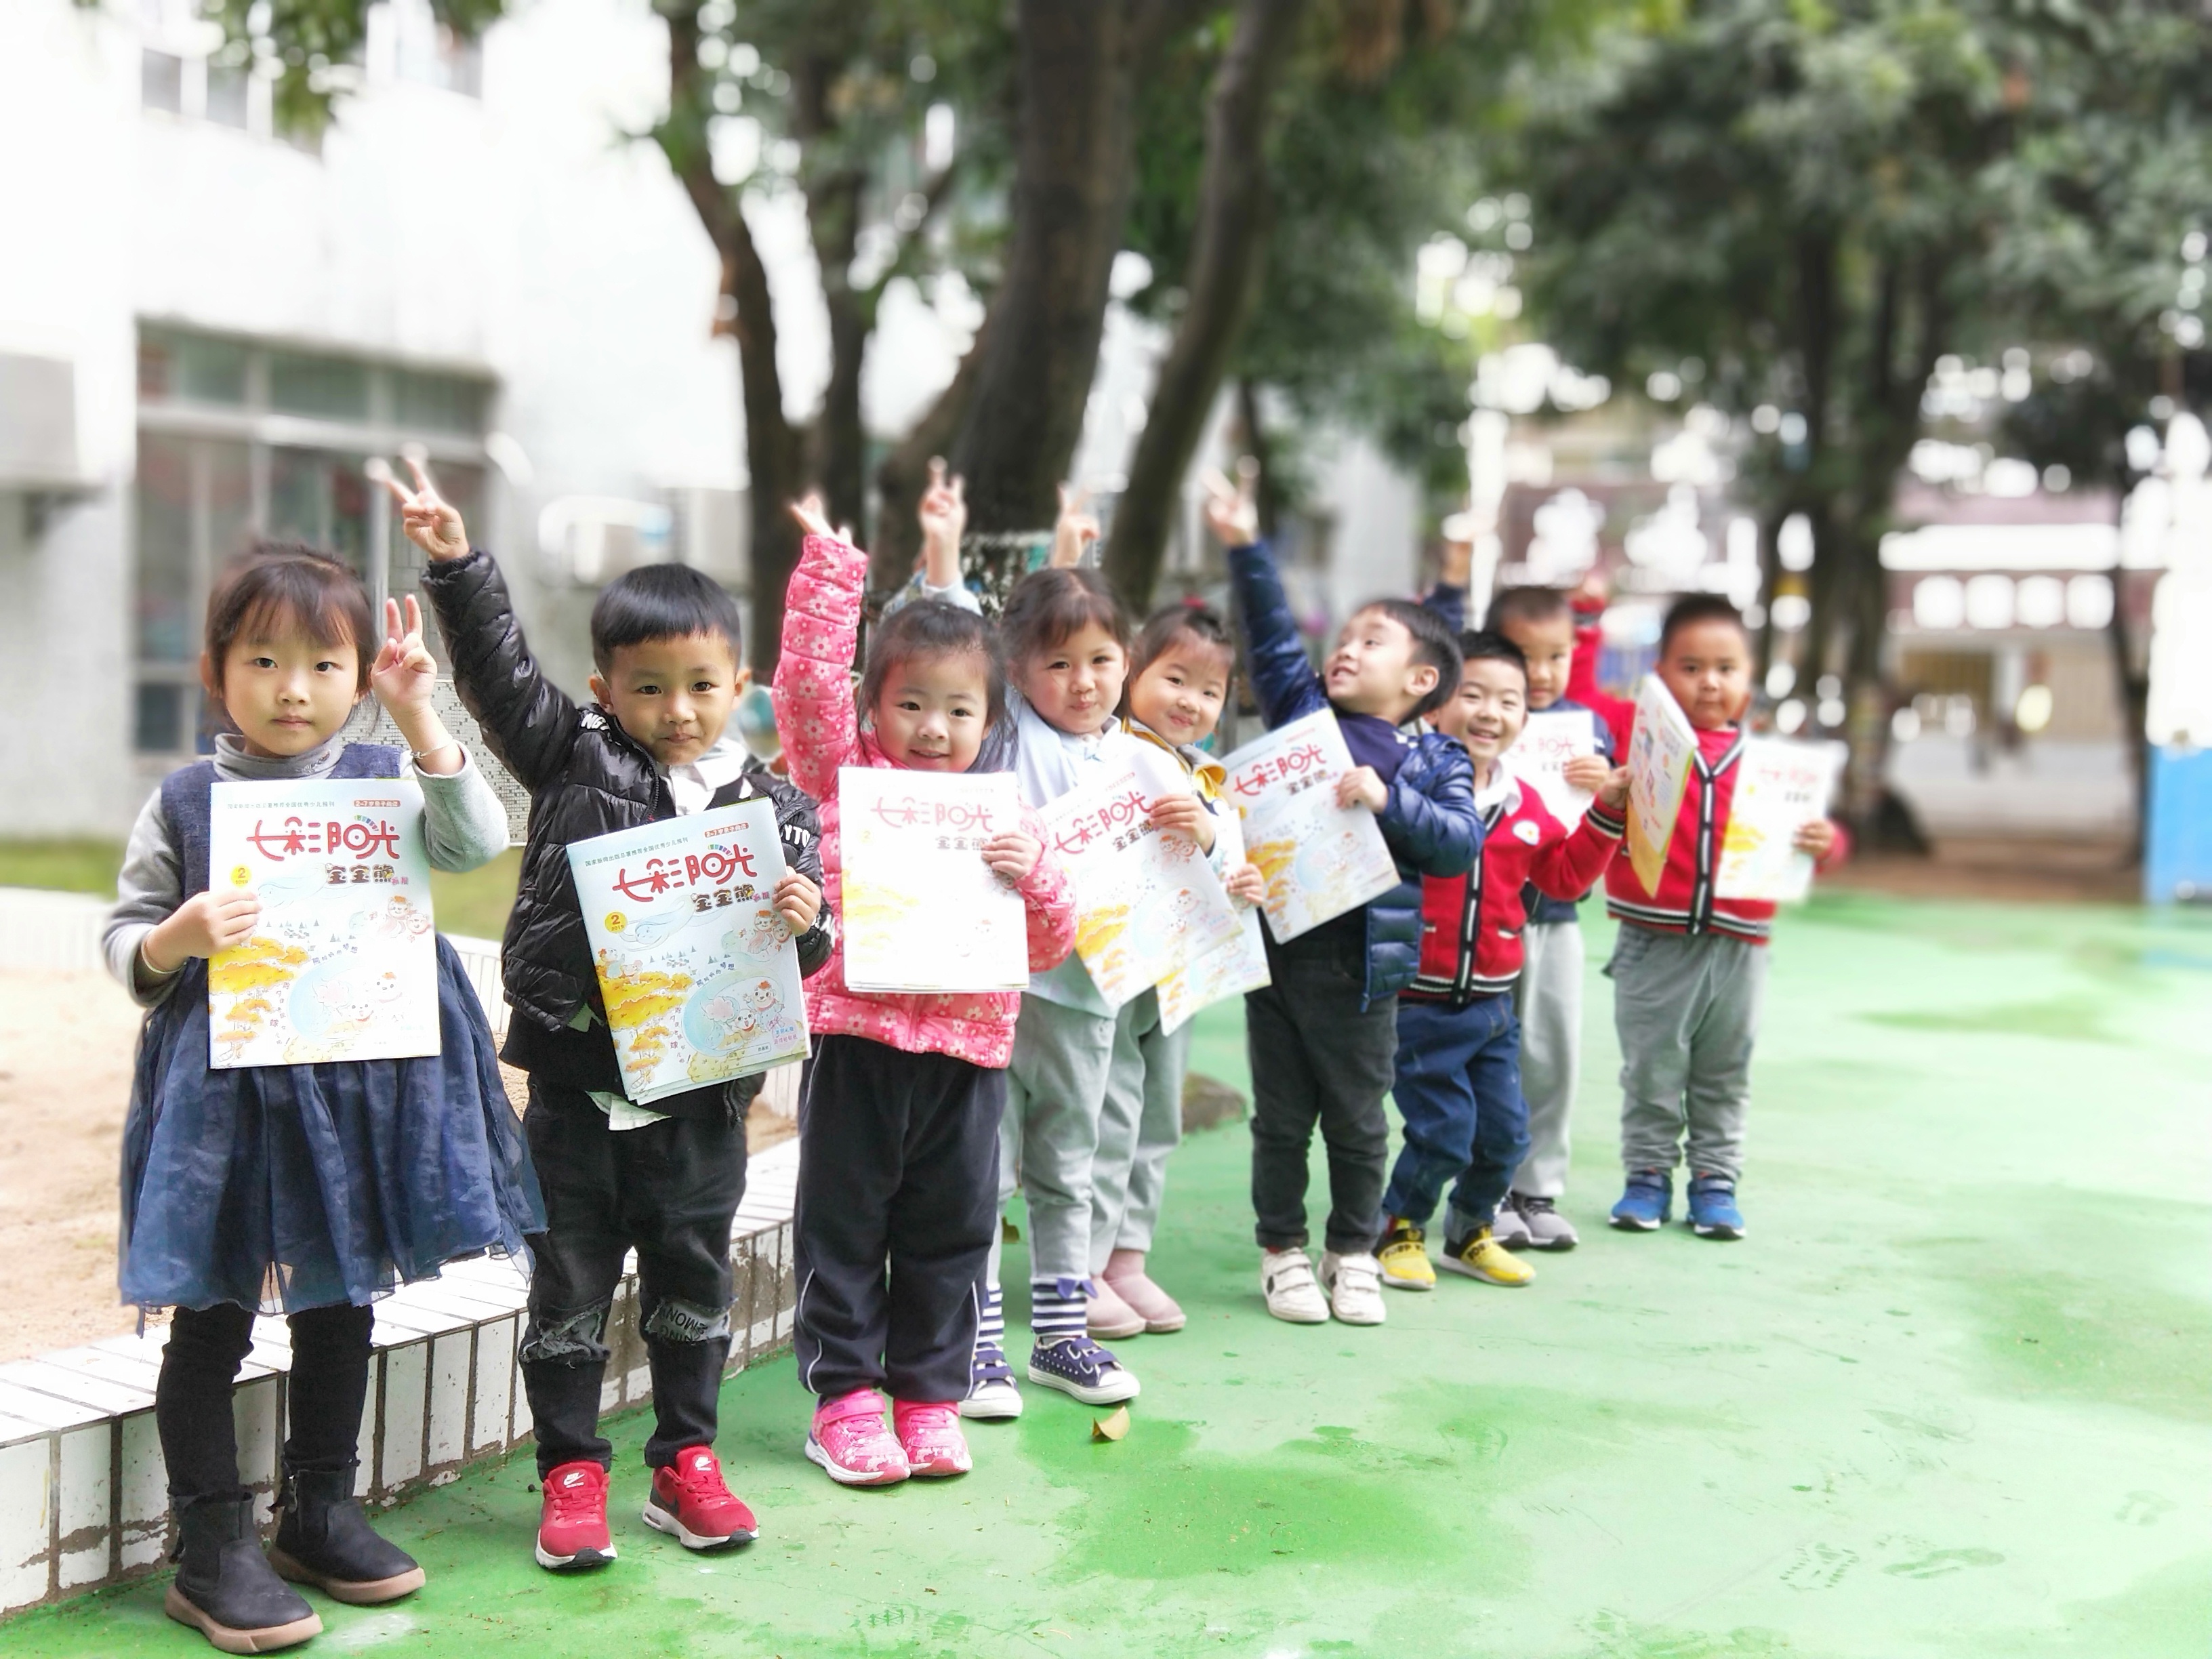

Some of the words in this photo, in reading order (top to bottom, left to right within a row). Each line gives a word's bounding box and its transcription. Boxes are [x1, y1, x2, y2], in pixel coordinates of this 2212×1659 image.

[870, 796, 994, 833] 七彩阳光
[1054, 791, 1153, 855] 七彩阳光
[247, 816, 401, 862] 七彩阳光
[237, 867, 246, 879] 2
[325, 863, 395, 885] 宝宝熊
[612, 844, 758, 903] 七彩阳光
[691, 883, 756, 913] 宝宝熊
[611, 914, 621, 926] 2
